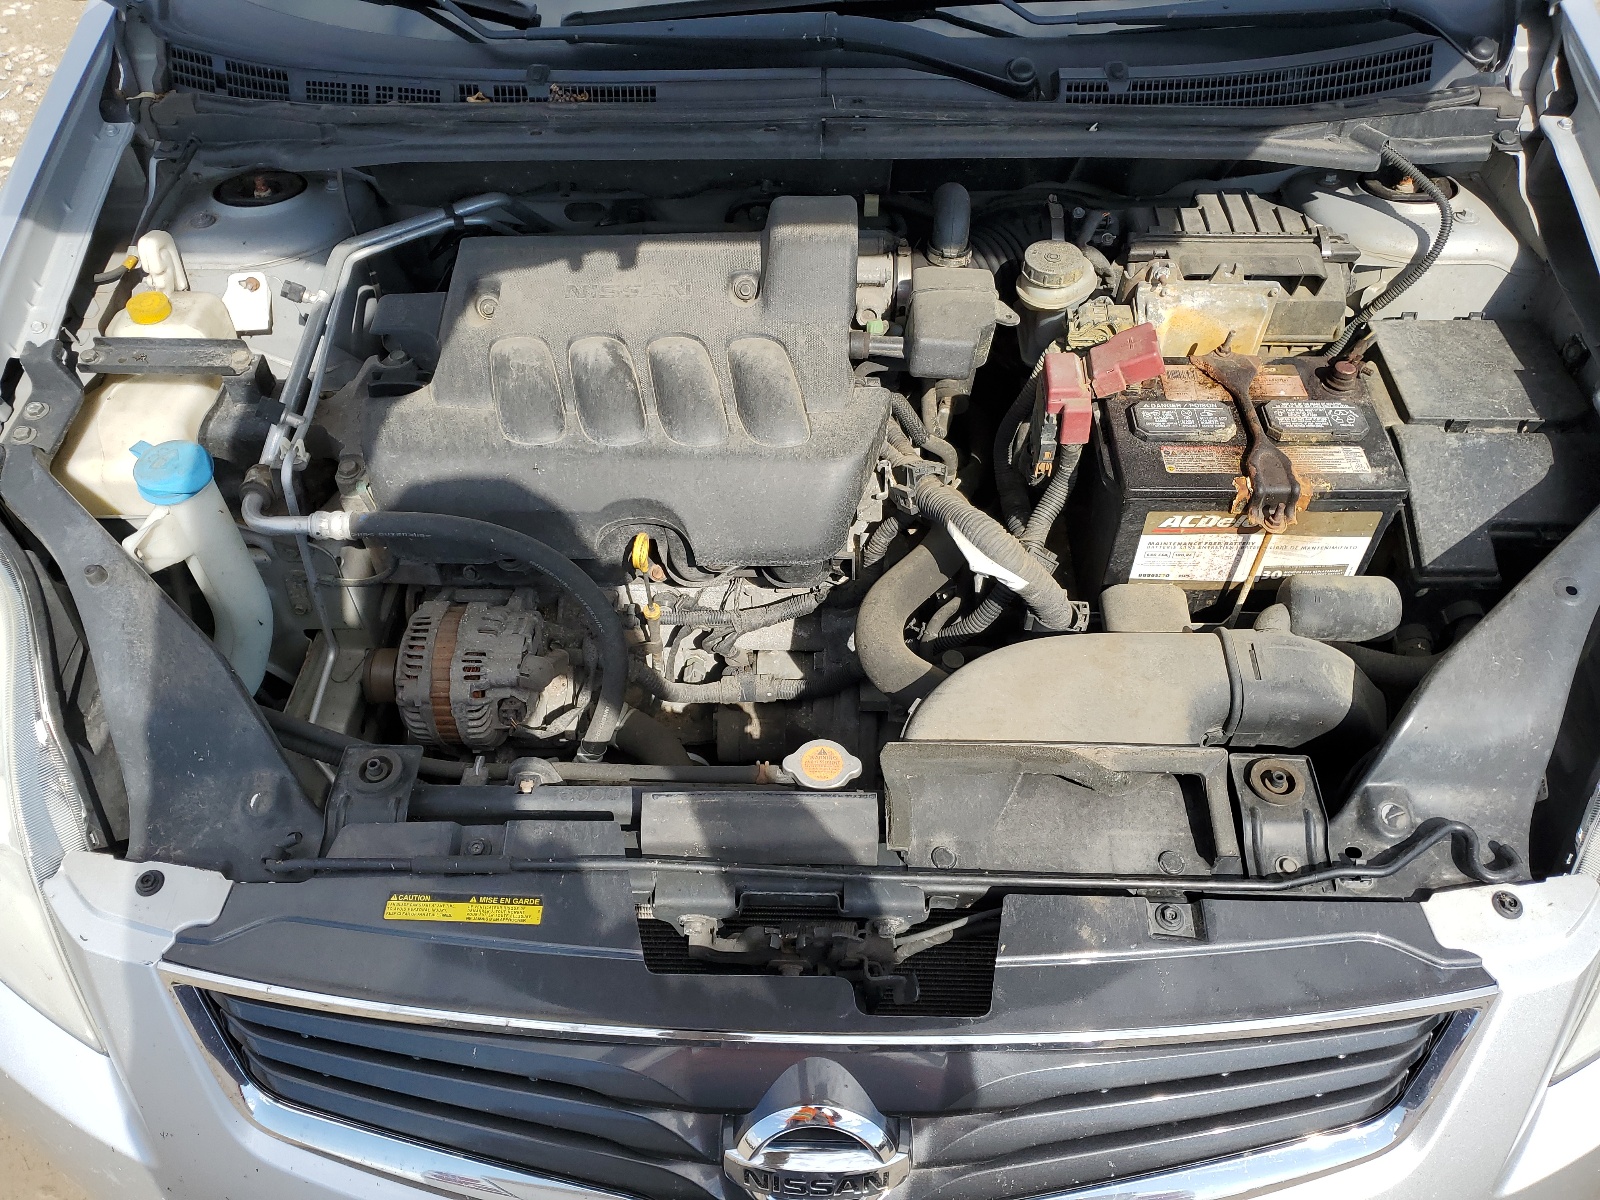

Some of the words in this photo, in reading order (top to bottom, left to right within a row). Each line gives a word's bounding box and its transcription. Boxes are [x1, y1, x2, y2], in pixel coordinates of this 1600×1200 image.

[564, 284, 692, 299] NISSAN
[398, 894, 431, 902] CAUTION
[479, 896, 499, 904] MISE
[743, 1169, 890, 1197] NISSAN
